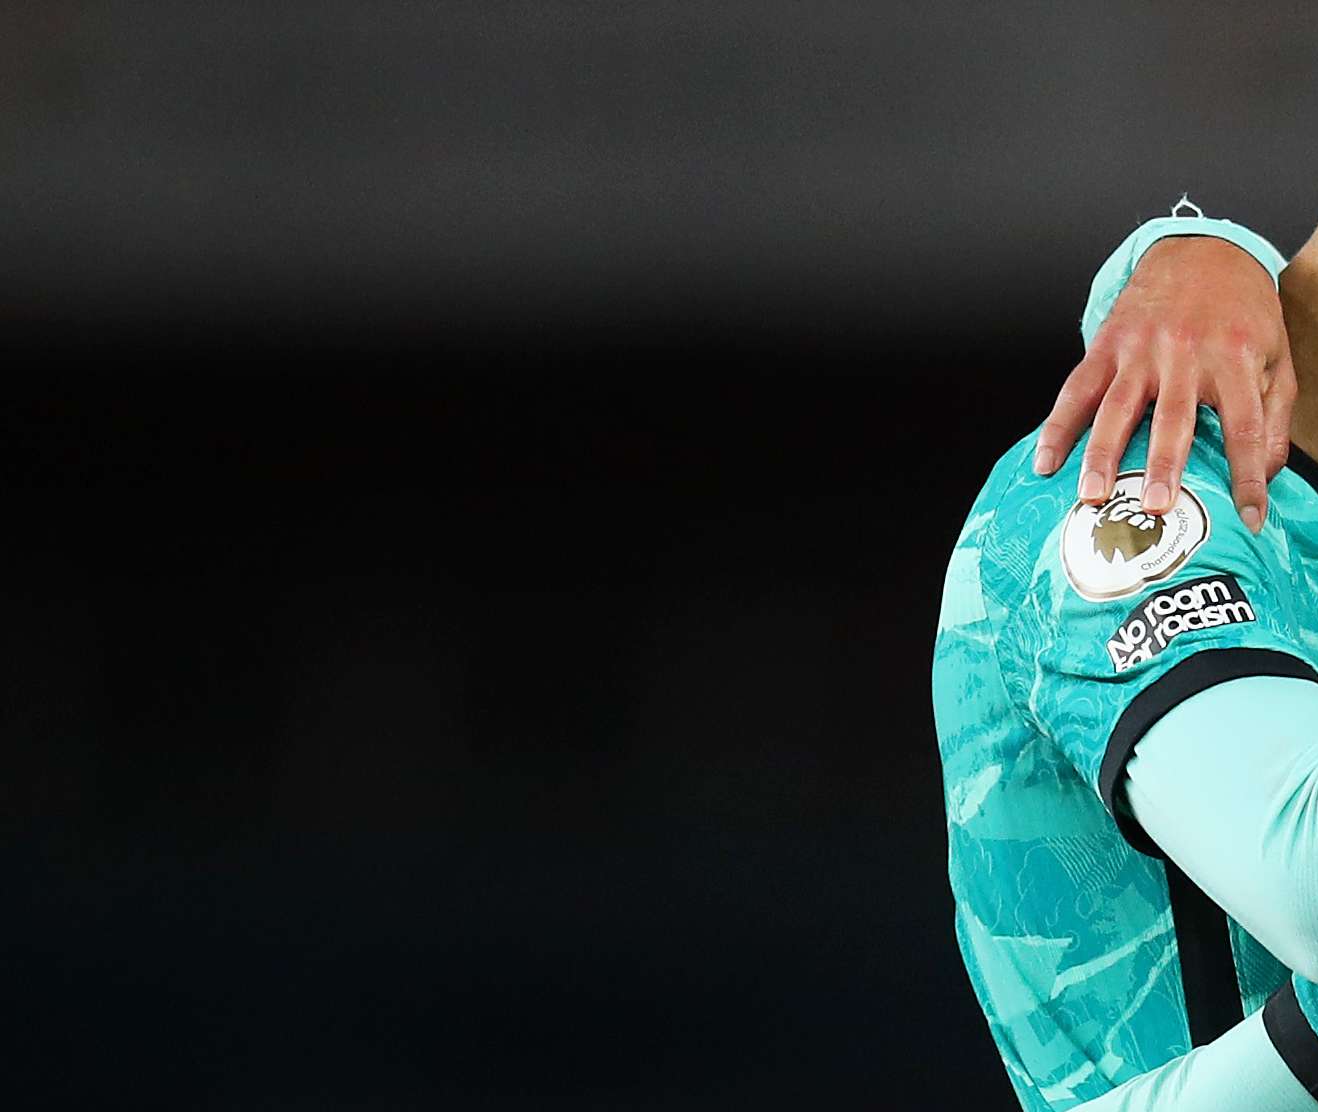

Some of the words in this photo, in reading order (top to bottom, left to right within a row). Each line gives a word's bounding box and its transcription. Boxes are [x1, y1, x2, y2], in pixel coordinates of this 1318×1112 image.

[1140, 532, 1185, 571] Champions
[1106, 619, 1147, 664] No
[1143, 580, 1232, 627] room
[1153, 600, 1255, 649] racism
